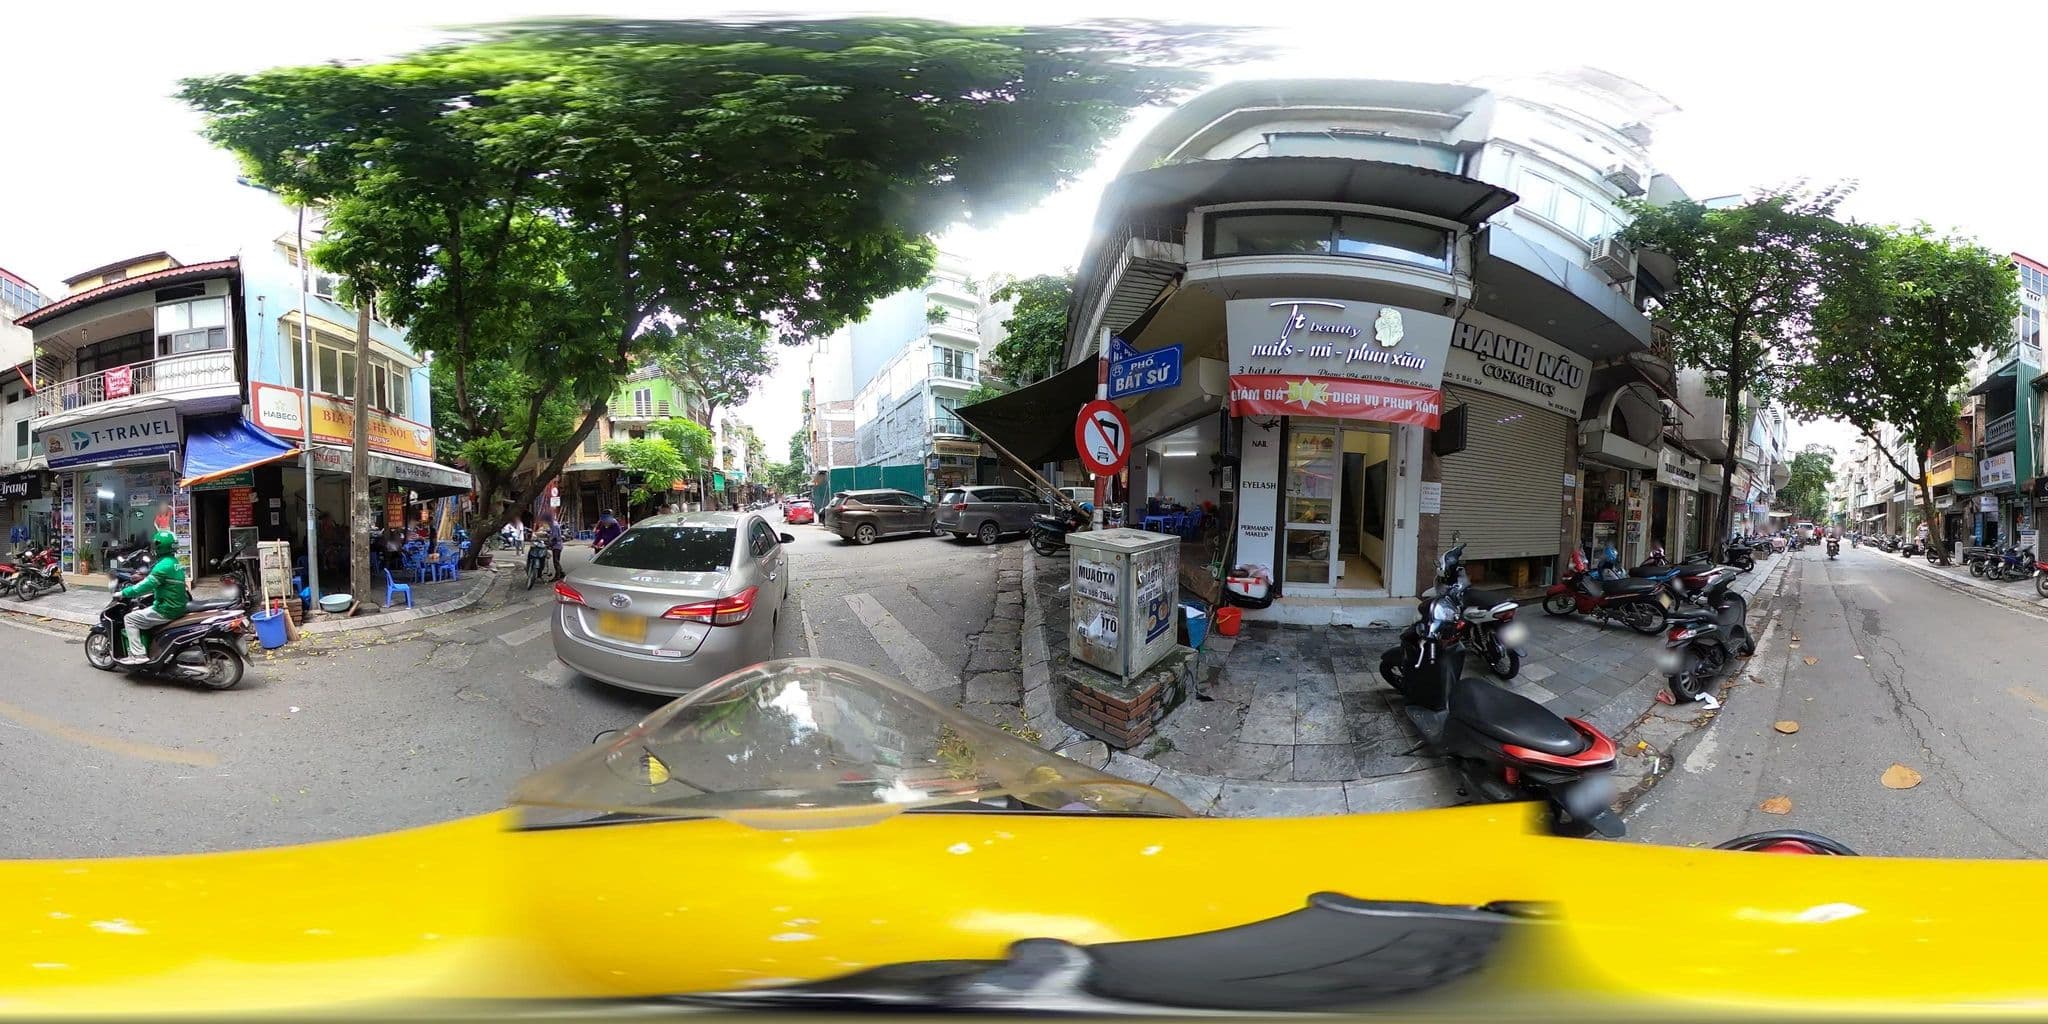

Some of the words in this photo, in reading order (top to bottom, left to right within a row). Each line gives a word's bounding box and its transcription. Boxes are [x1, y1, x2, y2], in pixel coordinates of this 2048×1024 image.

[1310, 321, 1361, 338] beauty
[1131, 355, 1154, 371] PHỐ
[1251, 339, 1293, 357] nails
[1310, 342, 1333, 358] mi
[1346, 342, 1389, 364] phun
[1391, 352, 1427, 370] xăm
[1452, 322, 1534, 369] HẠNH
[1537, 352, 1584, 390] NÂU
[1115, 371, 1143, 392] BÁT
[1147, 362, 1171, 385] SỨ
[1482, 362, 1556, 397] COSMETICS
[1332, 391, 1361, 406] DỊCH
[1364, 394, 1379, 409] VỤ
[1383, 396, 1413, 411] PHUN
[263, 410, 298, 421] HABECO
[322, 409, 346, 425] BIA
[92, 420, 175, 444] T-TRAVEL
[1251, 440, 1269, 448] NAIL
[1242, 481, 1277, 489] EYELASH
